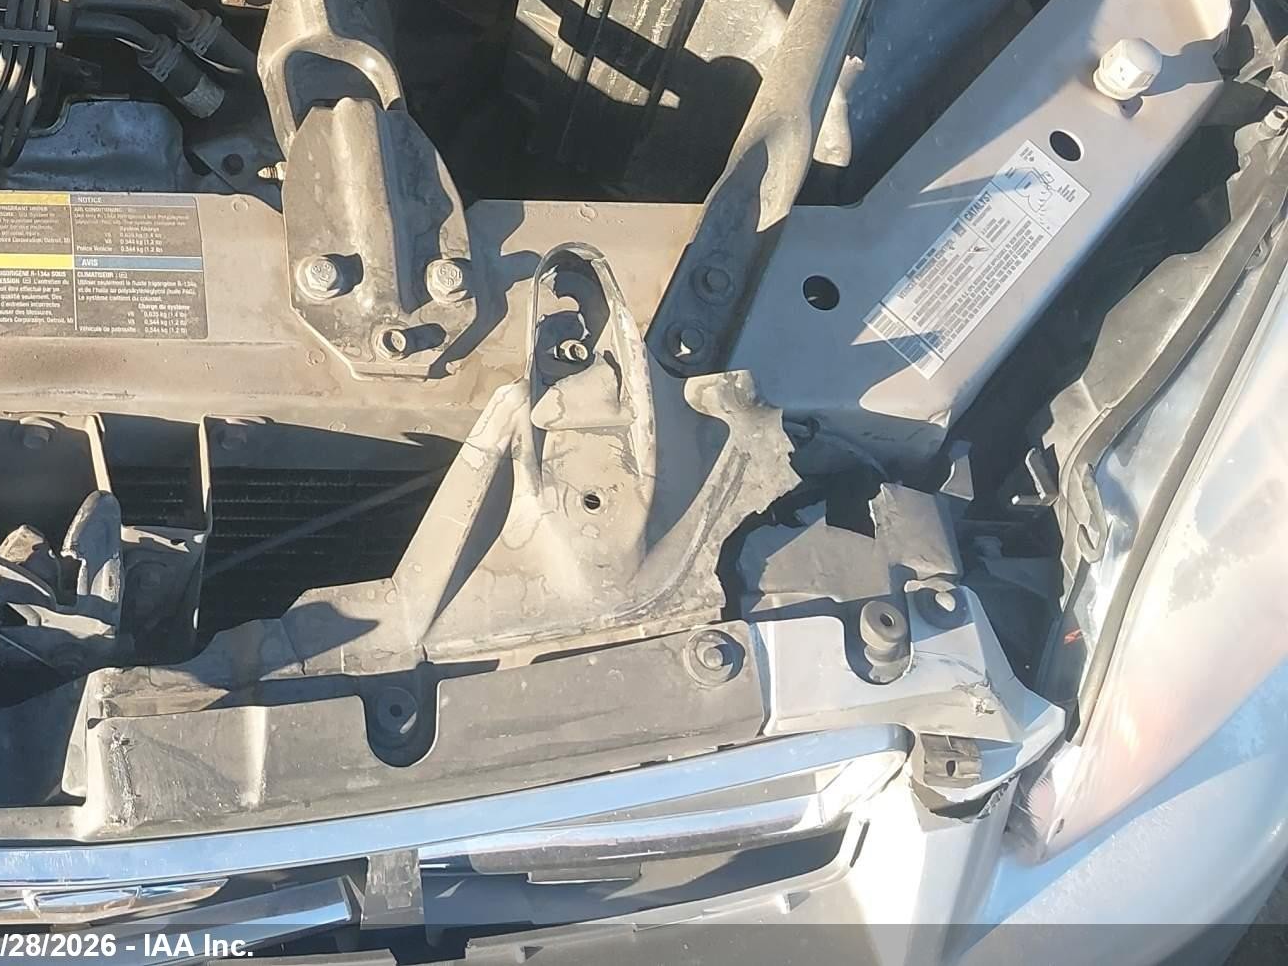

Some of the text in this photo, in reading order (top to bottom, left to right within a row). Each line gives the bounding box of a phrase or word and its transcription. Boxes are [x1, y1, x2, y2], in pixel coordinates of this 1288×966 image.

[78, 196, 103, 204] NOTICE
[963, 190, 994, 222] CATALYST
[82, 258, 99, 267] AVIS
